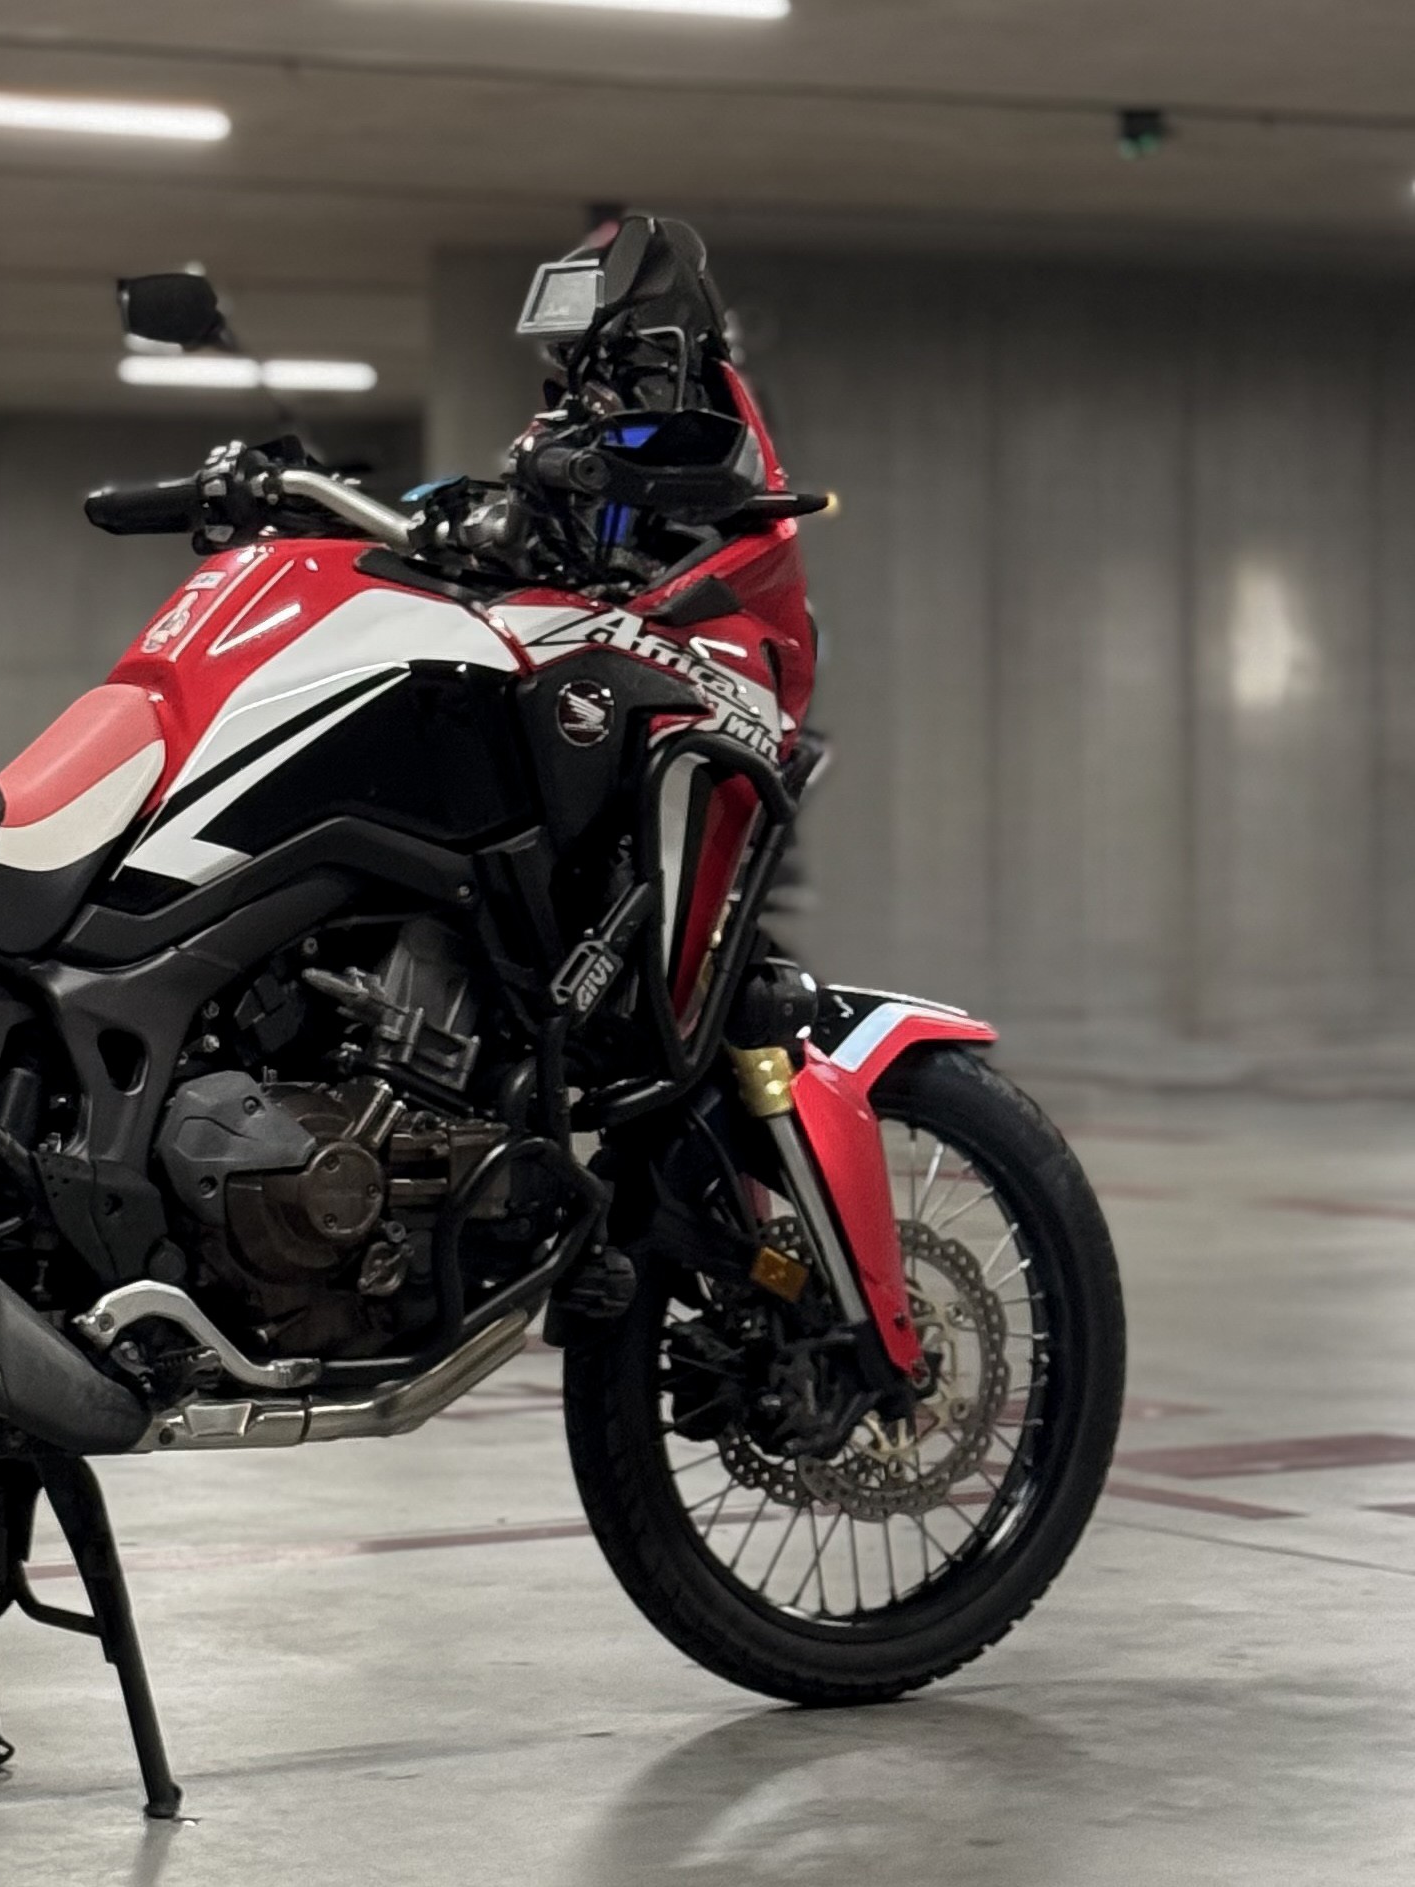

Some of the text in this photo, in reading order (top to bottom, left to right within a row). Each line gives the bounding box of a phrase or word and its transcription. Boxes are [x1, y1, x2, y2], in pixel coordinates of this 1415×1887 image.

[586, 607, 738, 696] Africa
[691, 688, 781, 766] Twin
[576, 955, 615, 1012] GIVI
